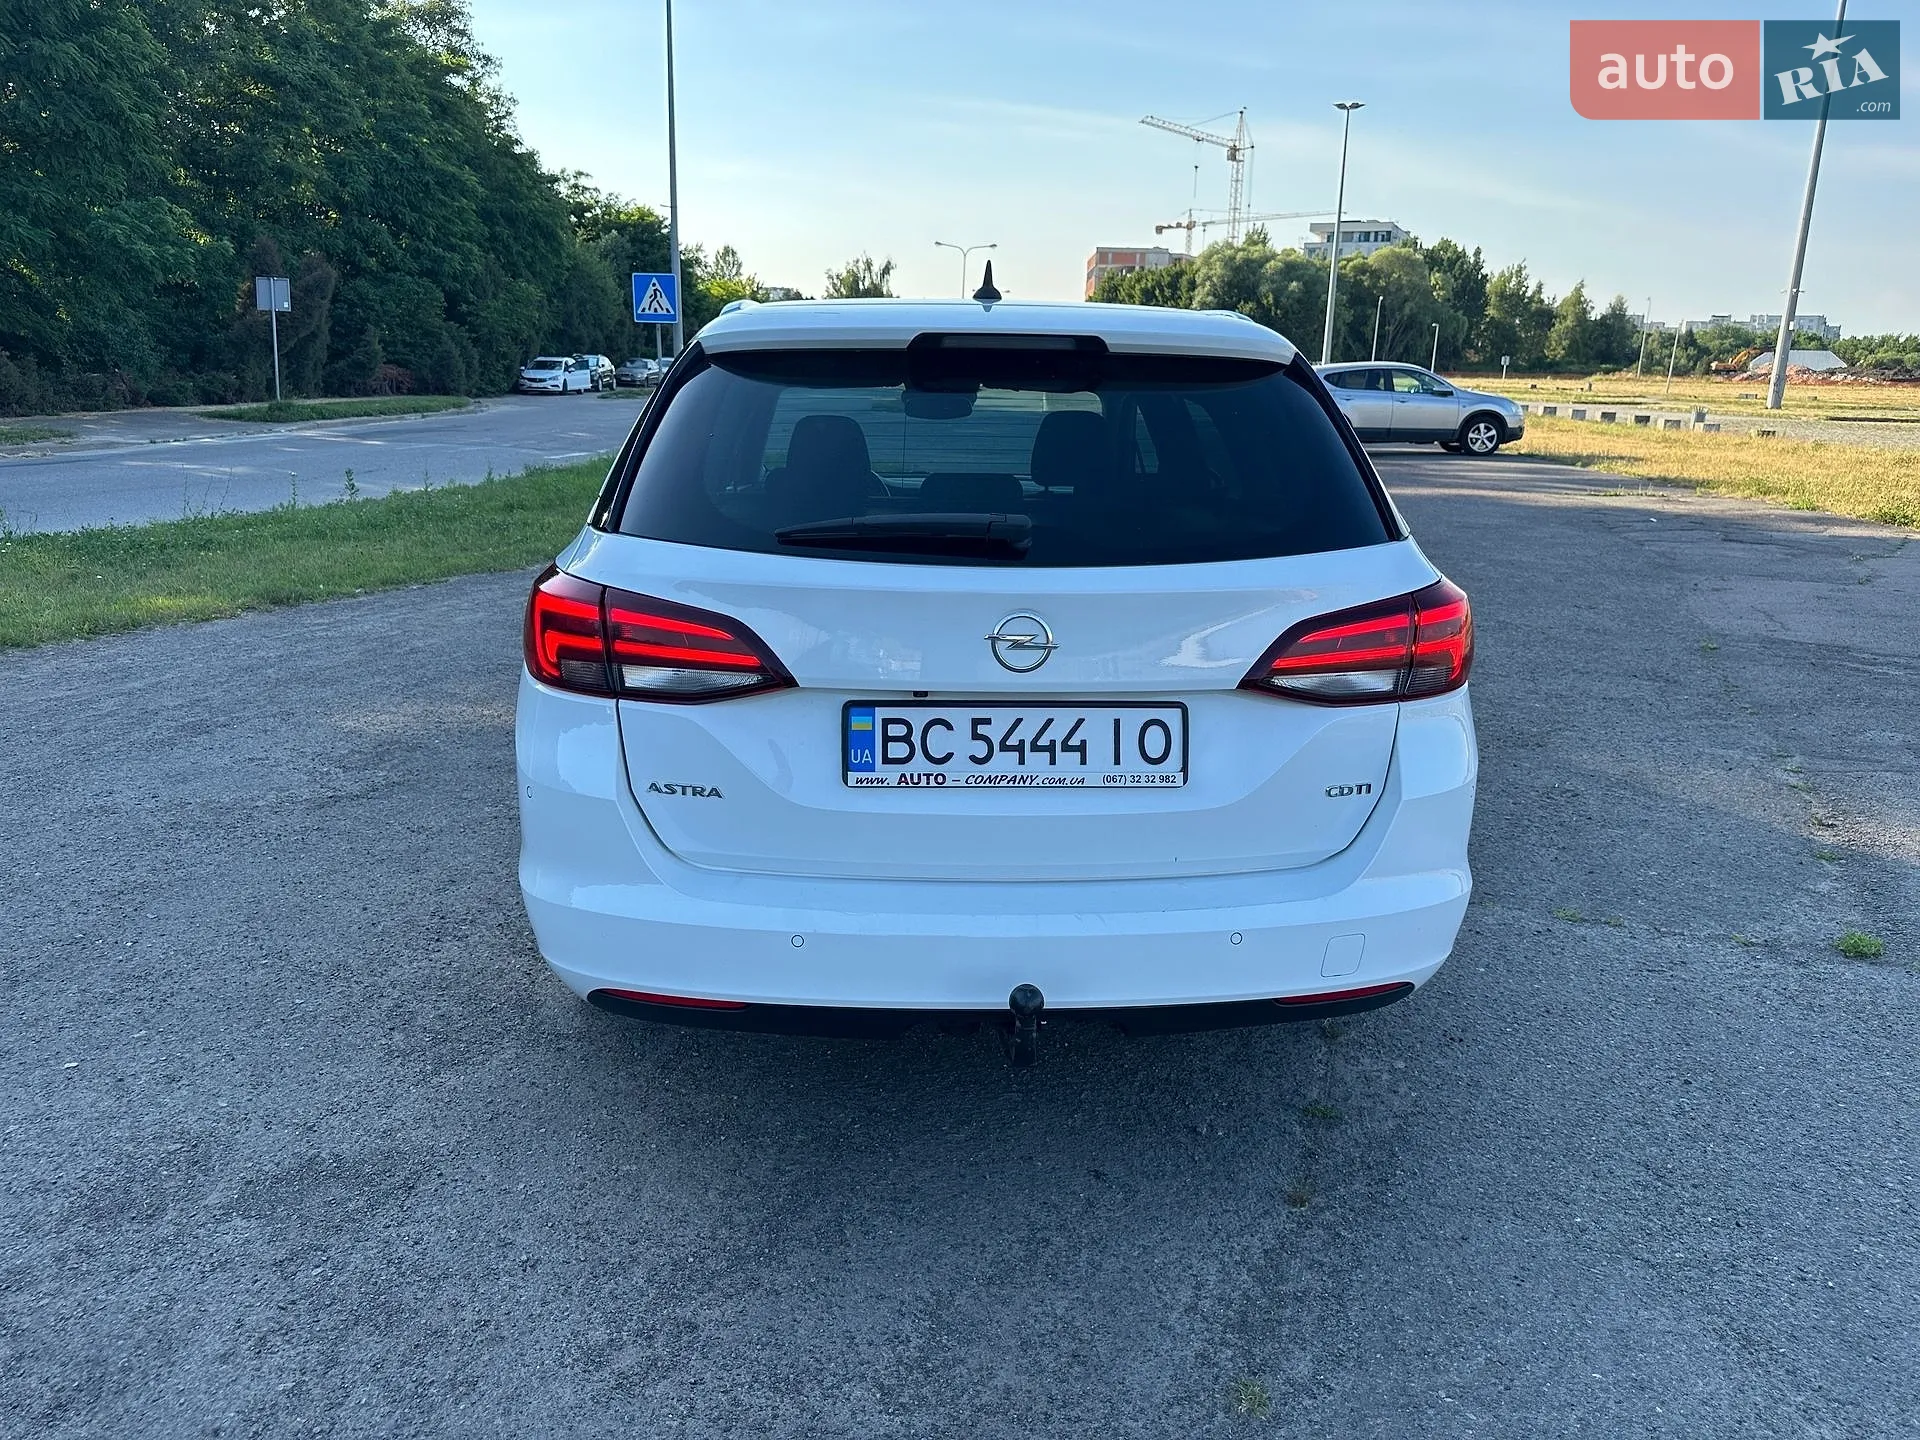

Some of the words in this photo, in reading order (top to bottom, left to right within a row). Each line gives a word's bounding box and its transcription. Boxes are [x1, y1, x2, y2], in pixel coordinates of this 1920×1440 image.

[881, 717, 955, 766] BC
[968, 717, 1087, 766] 5444
[851, 749, 873, 764] UA
[855, 776, 891, 786] www.
[897, 773, 947, 786] AUTO
[1102, 774, 1127, 785] (067)
[1130, 774, 1142, 784] 32
[1145, 774, 1156, 784] 32
[1159, 774, 1177, 784] 982
[648, 782, 723, 799] ASTRA
[1325, 783, 1372, 798] CDTI
